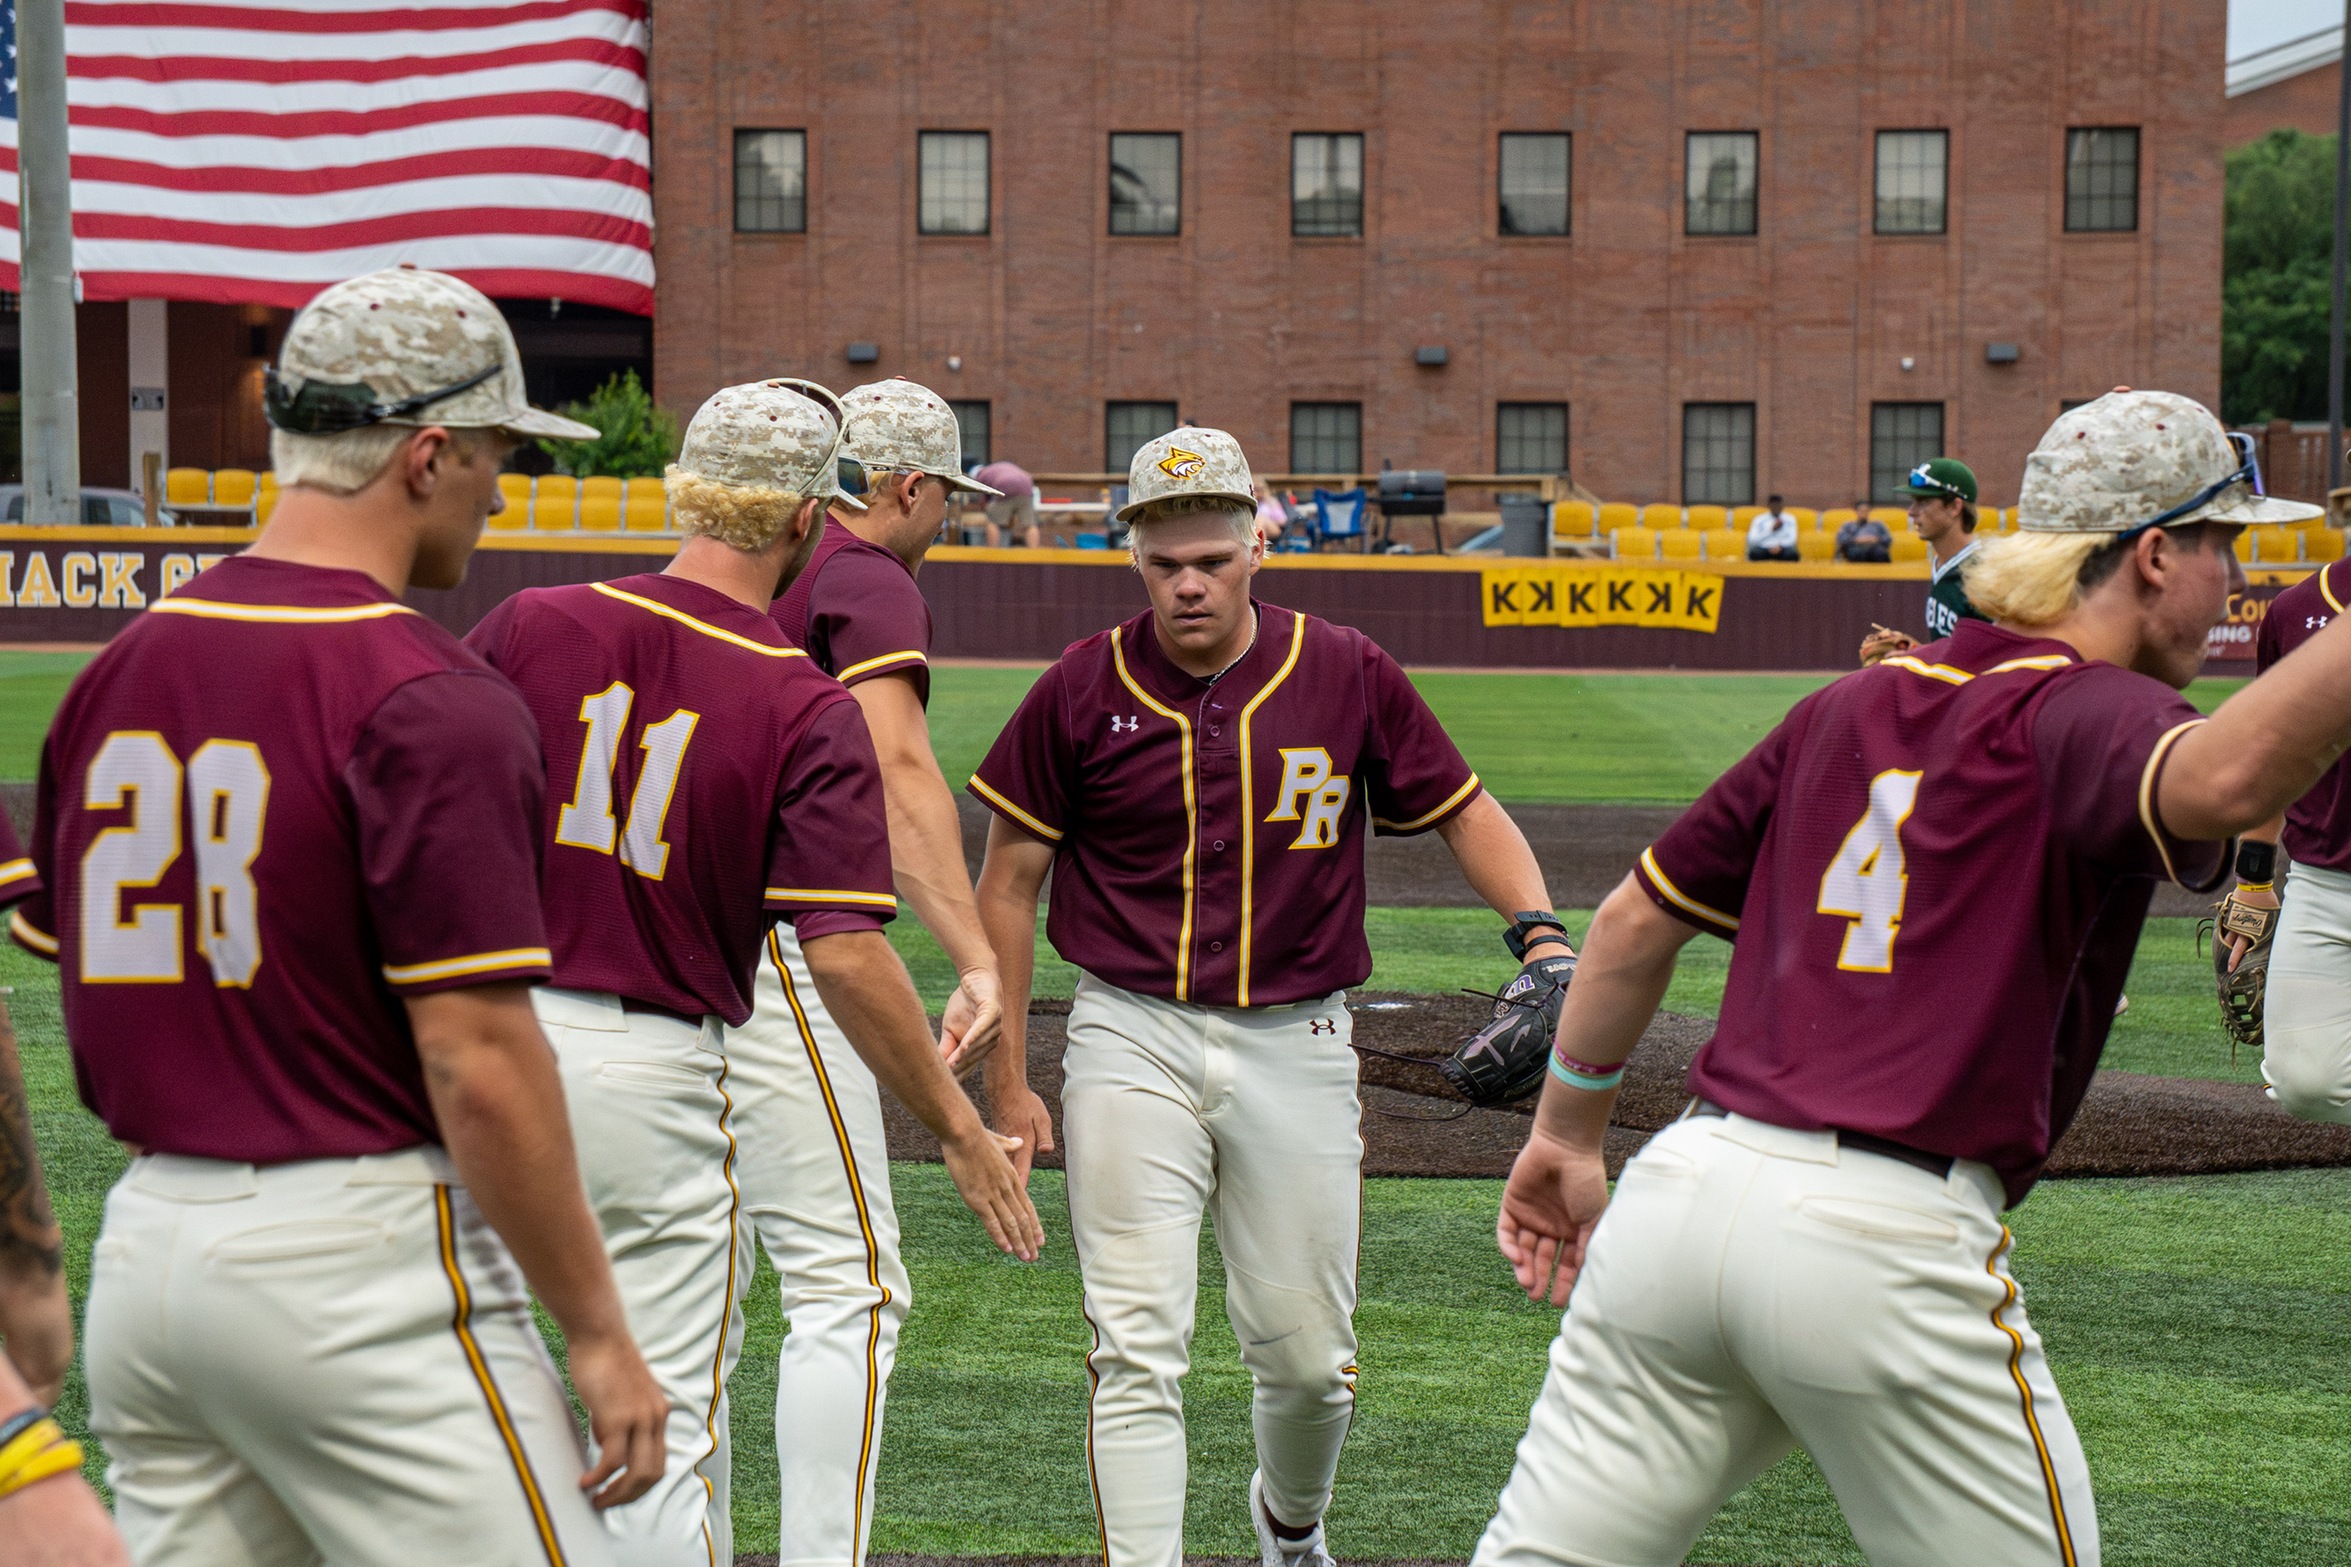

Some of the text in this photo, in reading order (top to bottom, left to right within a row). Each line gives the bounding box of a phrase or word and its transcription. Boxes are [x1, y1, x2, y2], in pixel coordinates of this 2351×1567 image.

[80, 730, 271, 990] 28
[555, 681, 700, 881] 11
[1263, 746, 1351, 850] PR
[1816, 768, 1925, 974] 4
